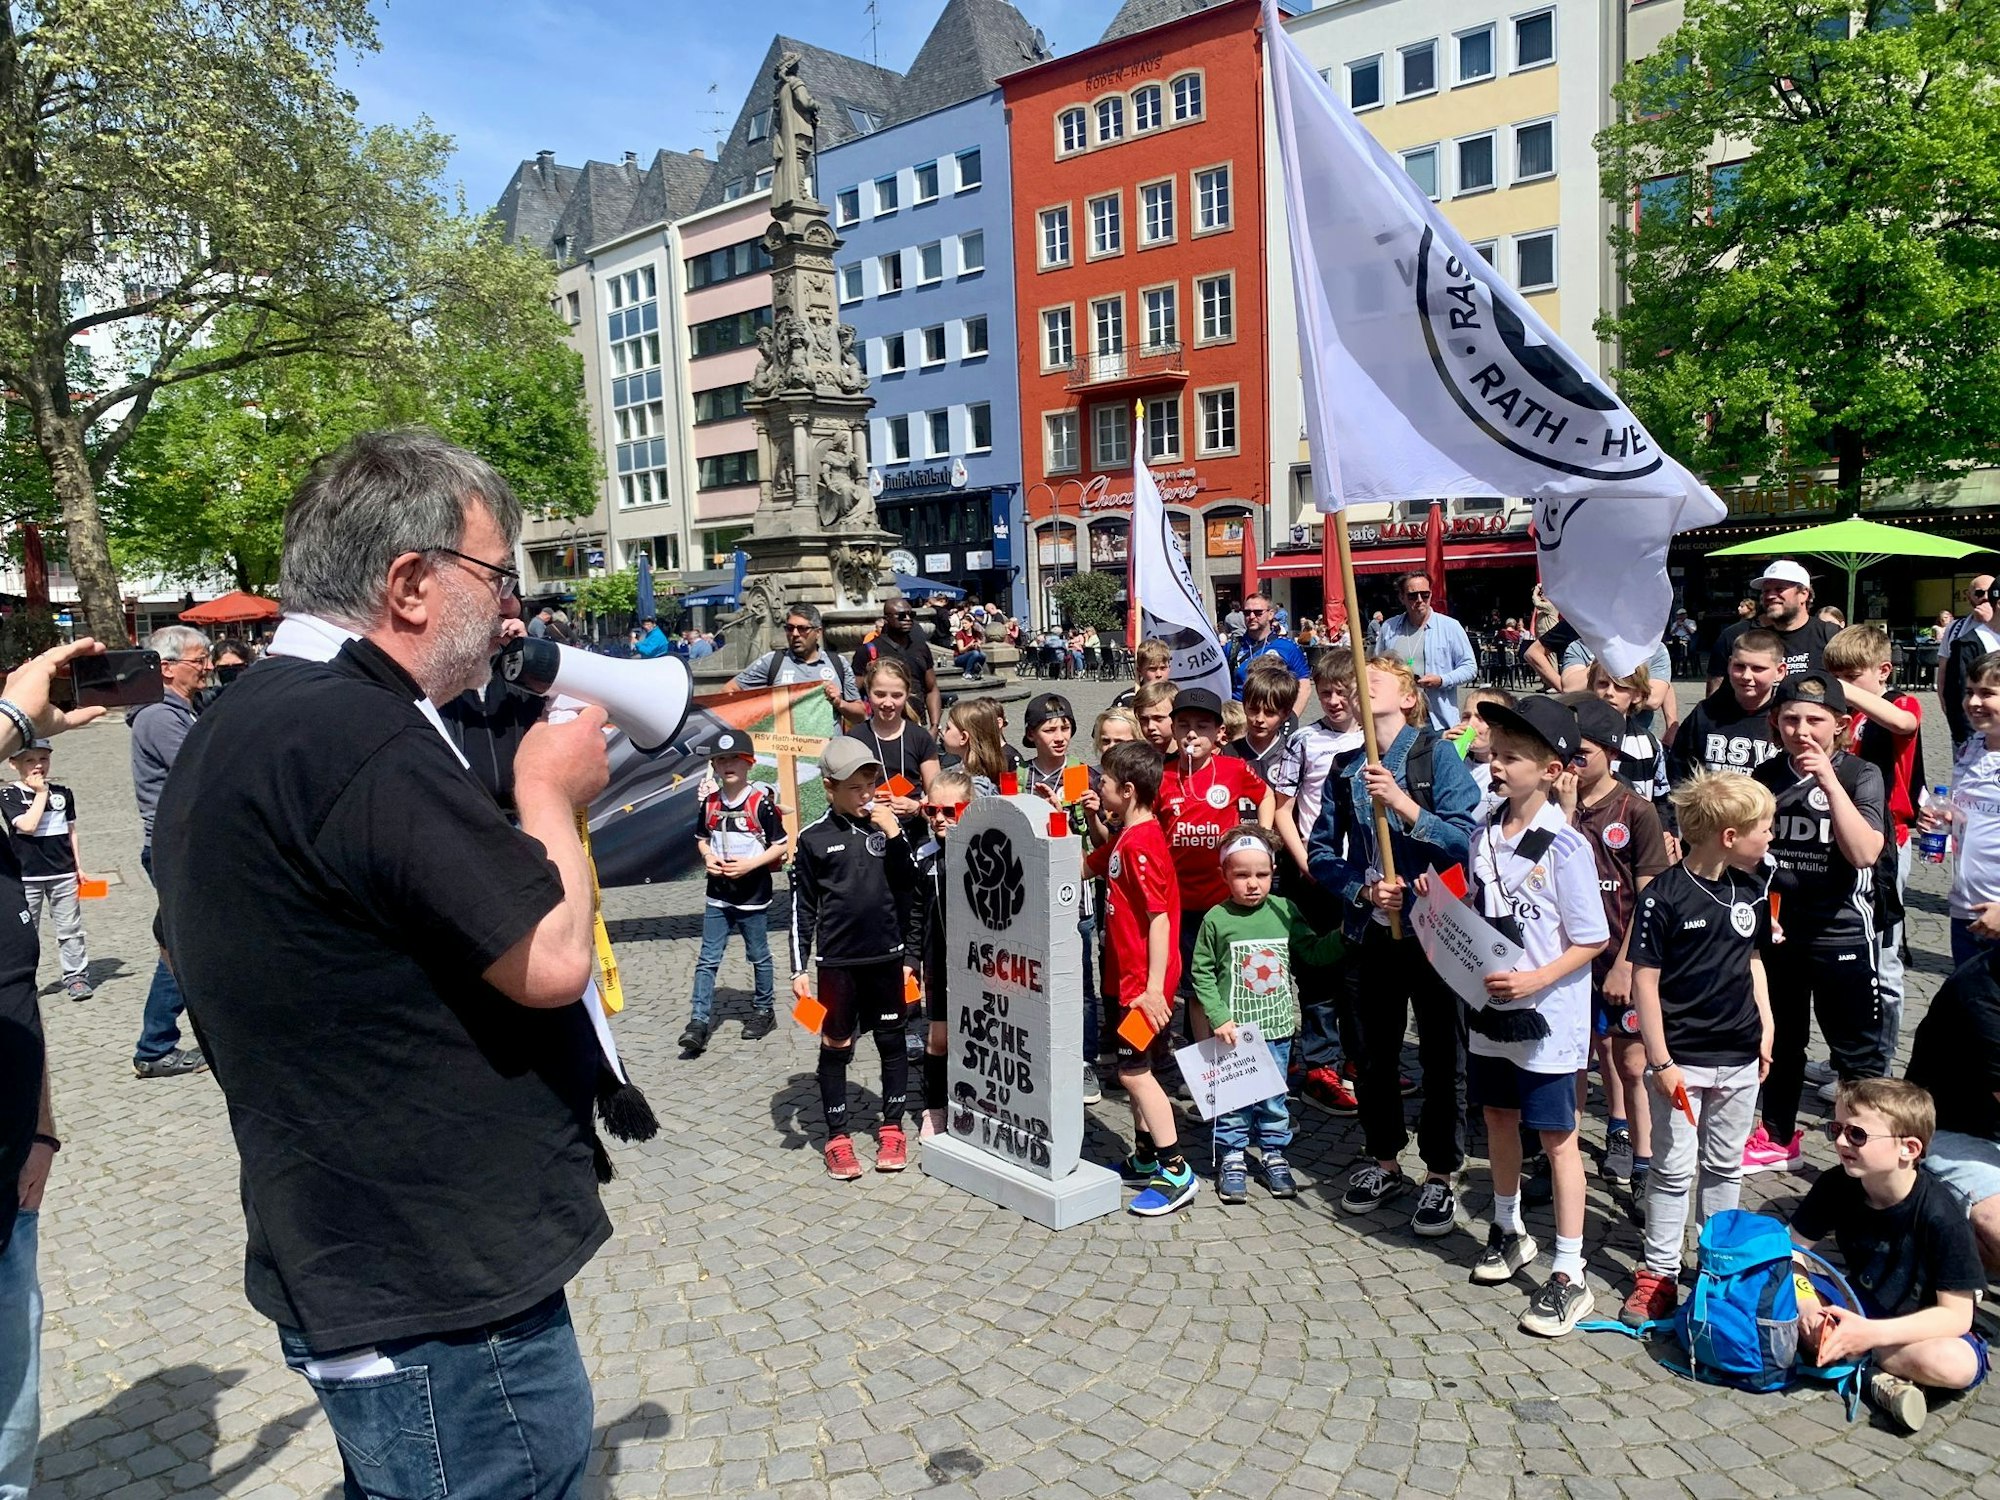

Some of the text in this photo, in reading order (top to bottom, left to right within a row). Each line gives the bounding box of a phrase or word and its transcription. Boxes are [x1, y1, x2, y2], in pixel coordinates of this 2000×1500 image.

[1469, 363, 1568, 445] RATH
[1079, 475, 1198, 508] Chocoterie
[1453, 513, 1506, 535] POLO
[1786, 662, 1809, 670] EREIN.
[754, 733, 822, 745] RSV Rath-Heumar
[771, 744, 789, 752] 1920
[1172, 804, 1181, 816] 3
[1176, 821, 1220, 835] Rhein
[827, 844, 846, 853] JAKO
[1797, 861, 1829, 873] Müller
[1683, 918, 1707, 930] JAKO
[1838, 953, 1857, 961] JAKO
[967, 940, 1043, 994] ASCHE
[1459, 956, 1475, 973] Wir
[982, 990, 1010, 1018] ZU
[880, 1012, 899, 1021] JAKO
[959, 1005, 1032, 1063] ASCHE
[962, 1040, 1034, 1094] STAUB
[1220, 1063, 1232, 1072] die
[1233, 1056, 1256, 1068] Politik
[1244, 1065, 1258, 1075] Wir
[1221, 1070, 1244, 1083] zeigen
[888, 1094, 906, 1103] JAKO
[985, 1080, 1011, 1106] ZU
[828, 1103, 846, 1113] JAKO
